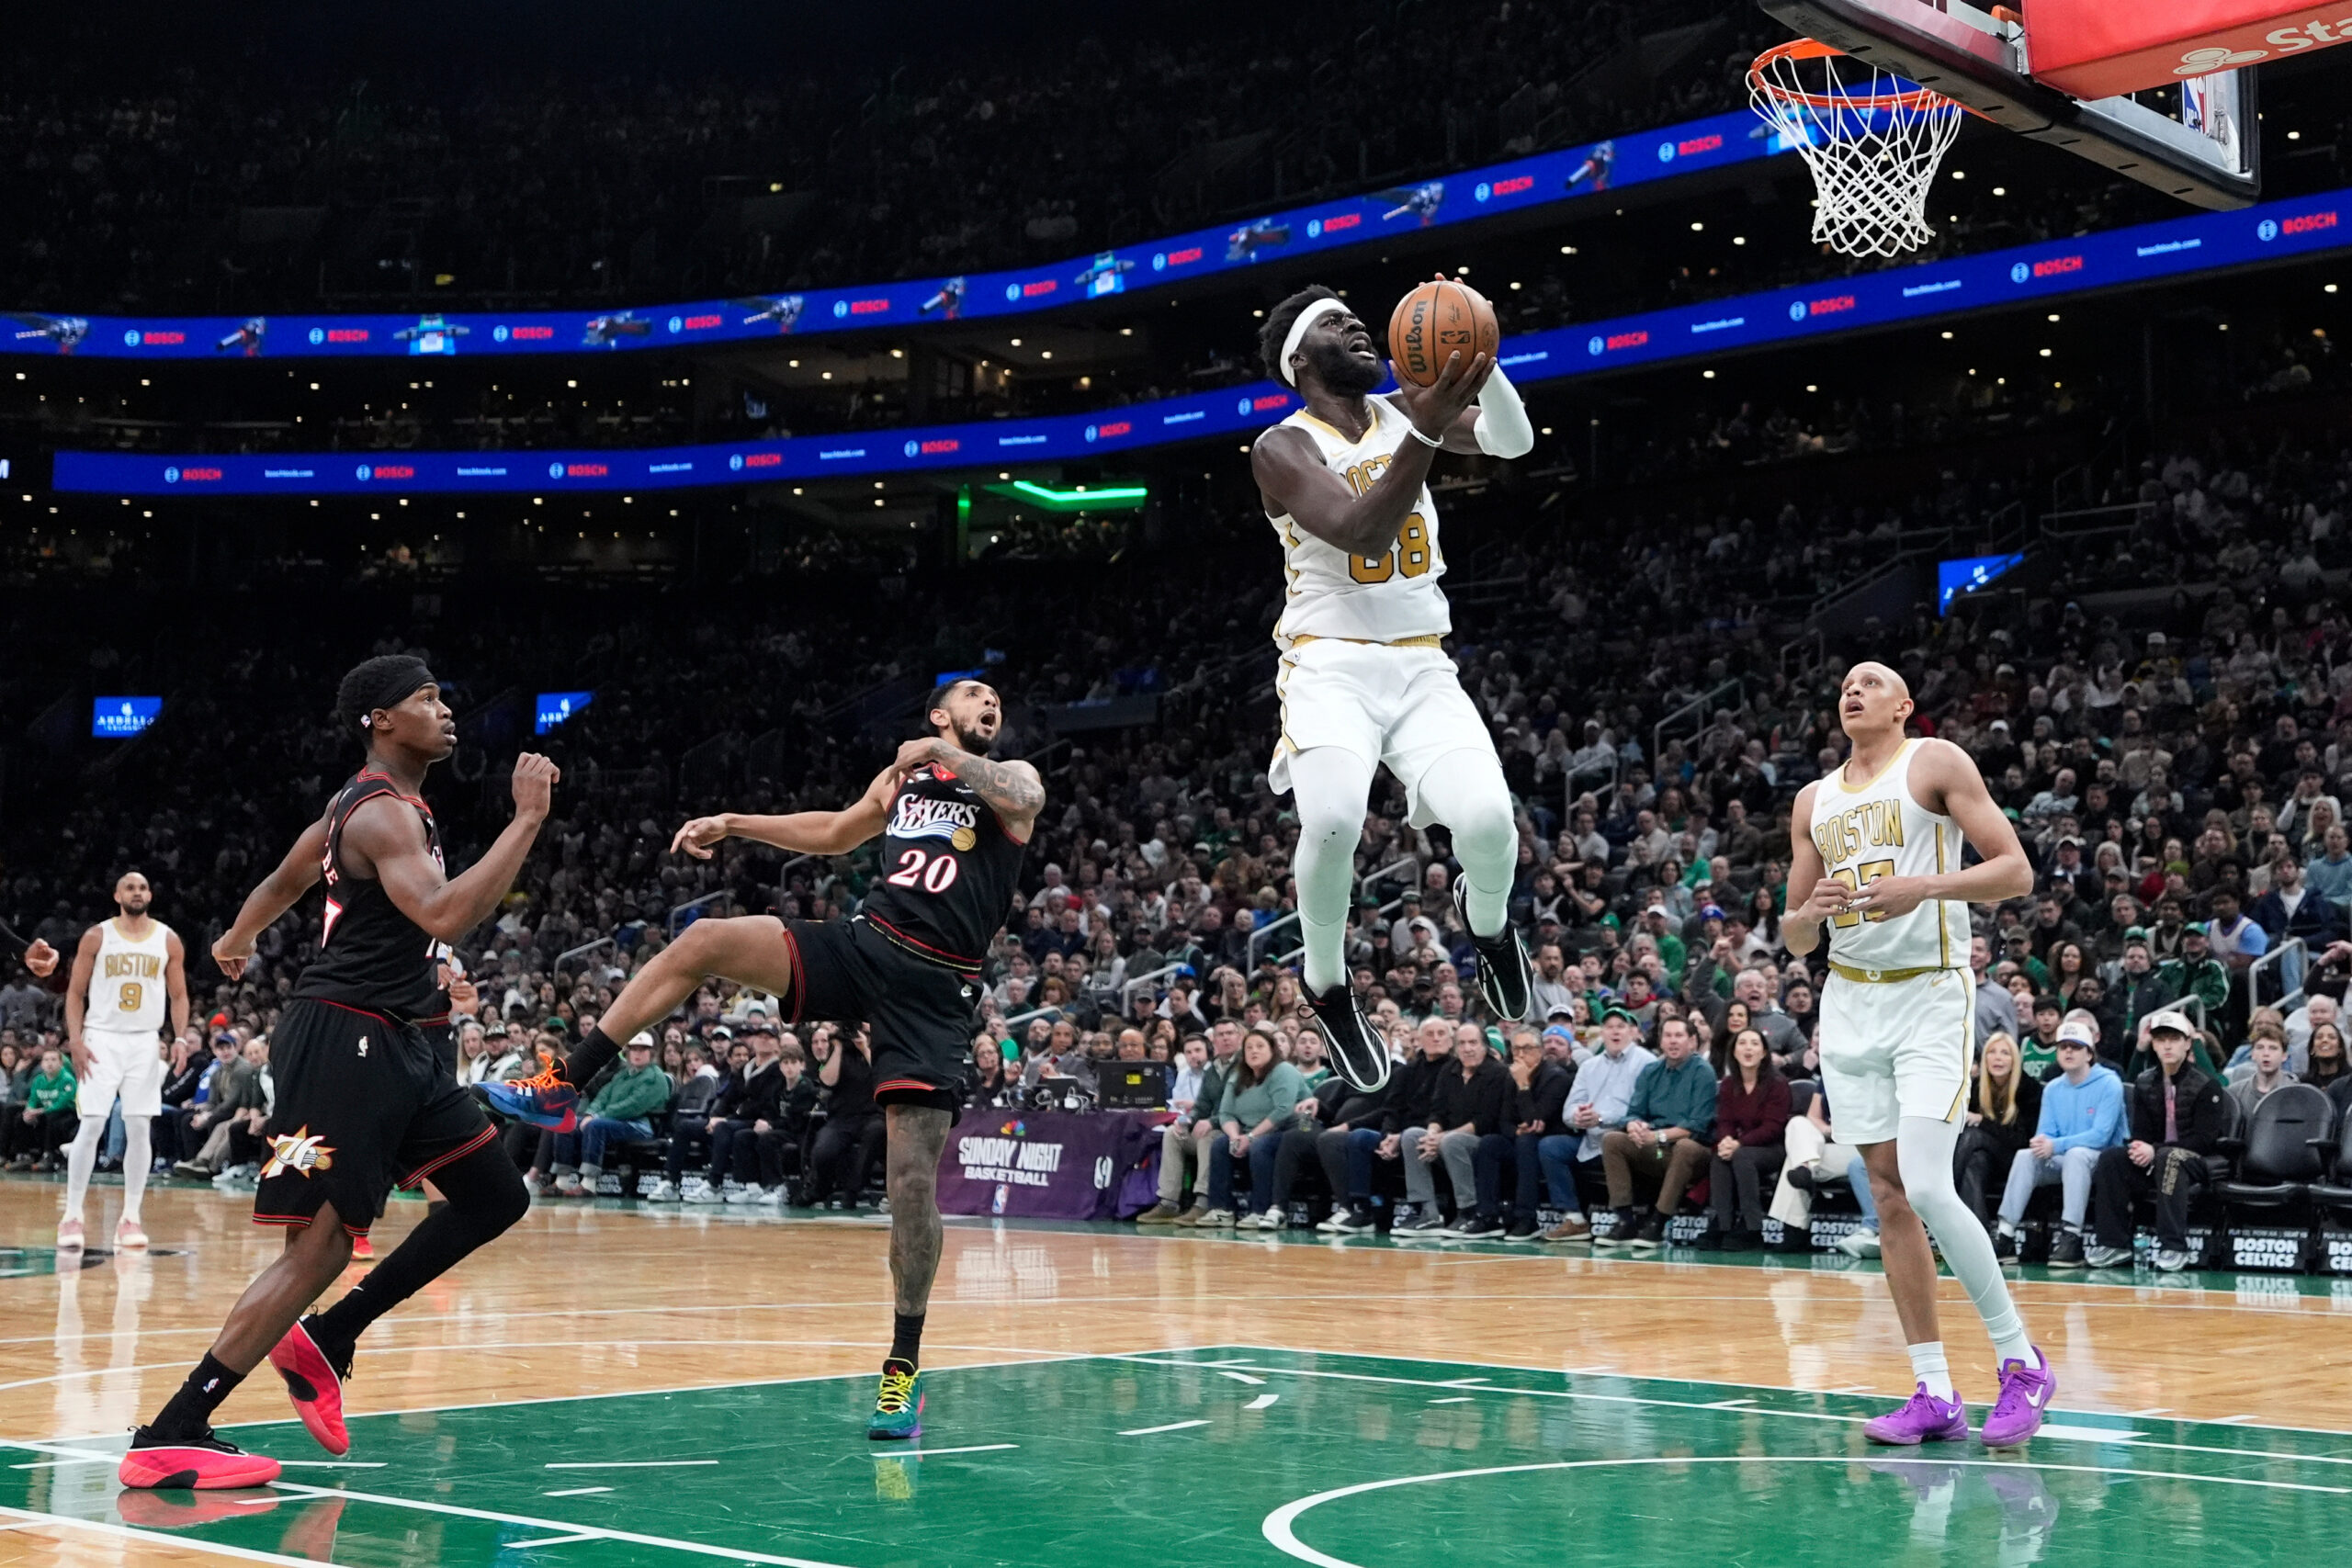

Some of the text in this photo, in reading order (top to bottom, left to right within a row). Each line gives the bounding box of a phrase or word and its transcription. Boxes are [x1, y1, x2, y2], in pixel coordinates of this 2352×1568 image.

[1679, 135, 1723, 156] BOSCH
[1493, 175, 1533, 196] BOSCH
[1323, 214, 1361, 232] BOSCH
[2282, 212, 2337, 234] BOSCH
[1168, 248, 1202, 265] BOSCH
[2033, 256, 2083, 277] BOSCH
[1023, 280, 1057, 297] BOSCH
[851, 299, 889, 314] BOSCH
[1810, 296, 1855, 315] BOSCH
[685, 315, 721, 330] BOSCH
[143, 332, 185, 344] BOSCH
[327, 329, 369, 342] BOSCH
[512, 326, 554, 339] BOSCH
[1405, 300, 1429, 374] Wilson
[1607, 332, 1648, 350] BOSCH
[1253, 395, 1288, 411] BOSCH
[1099, 422, 1131, 437] BOSCH
[921, 440, 959, 454] BOSCH
[745, 454, 782, 467] BOSCH
[182, 468, 222, 480] BOSCH
[374, 466, 414, 479] BOSCH
[567, 464, 608, 477] BOSCH
[1814, 798, 1905, 870] BOSTON
[887, 848, 959, 895] 20
[105, 952, 161, 981] BOSTON
[119, 982, 142, 1013] 9
[265, 1134, 326, 1179] 76
[958, 1135, 1064, 1173] SUNDAY NIGHT
[964, 1166, 1050, 1188] BASKETBALL
[2233, 1237, 2299, 1254] BOSTON
[2234, 1251, 2295, 1268] CELTICS
